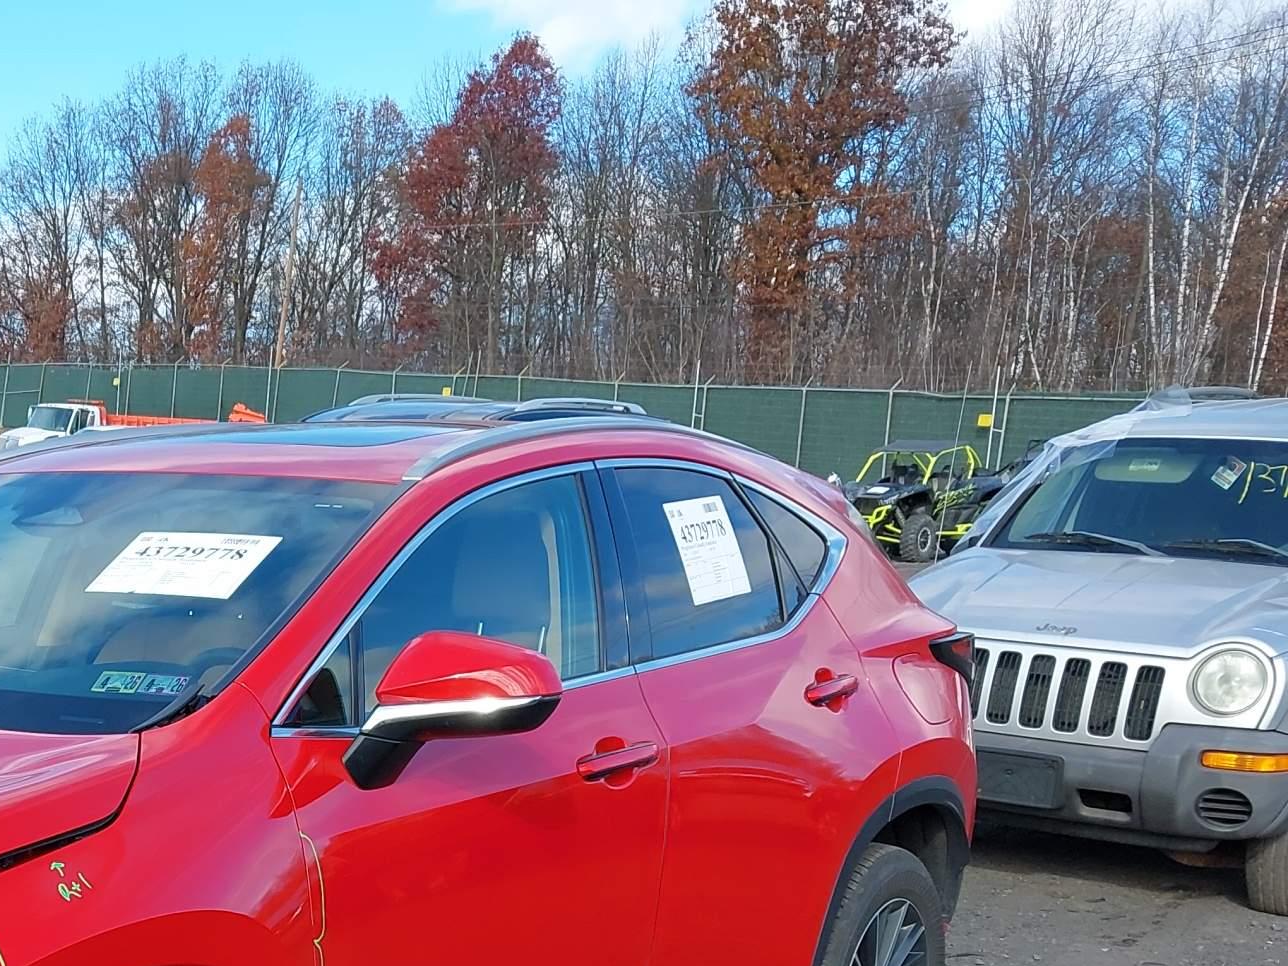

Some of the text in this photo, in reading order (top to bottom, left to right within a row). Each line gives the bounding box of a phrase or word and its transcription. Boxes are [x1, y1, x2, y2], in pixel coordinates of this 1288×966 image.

[680, 518, 727, 543] 43729778
[135, 546, 248, 560] 43729778
[1035, 623, 1078, 636] Jeep
